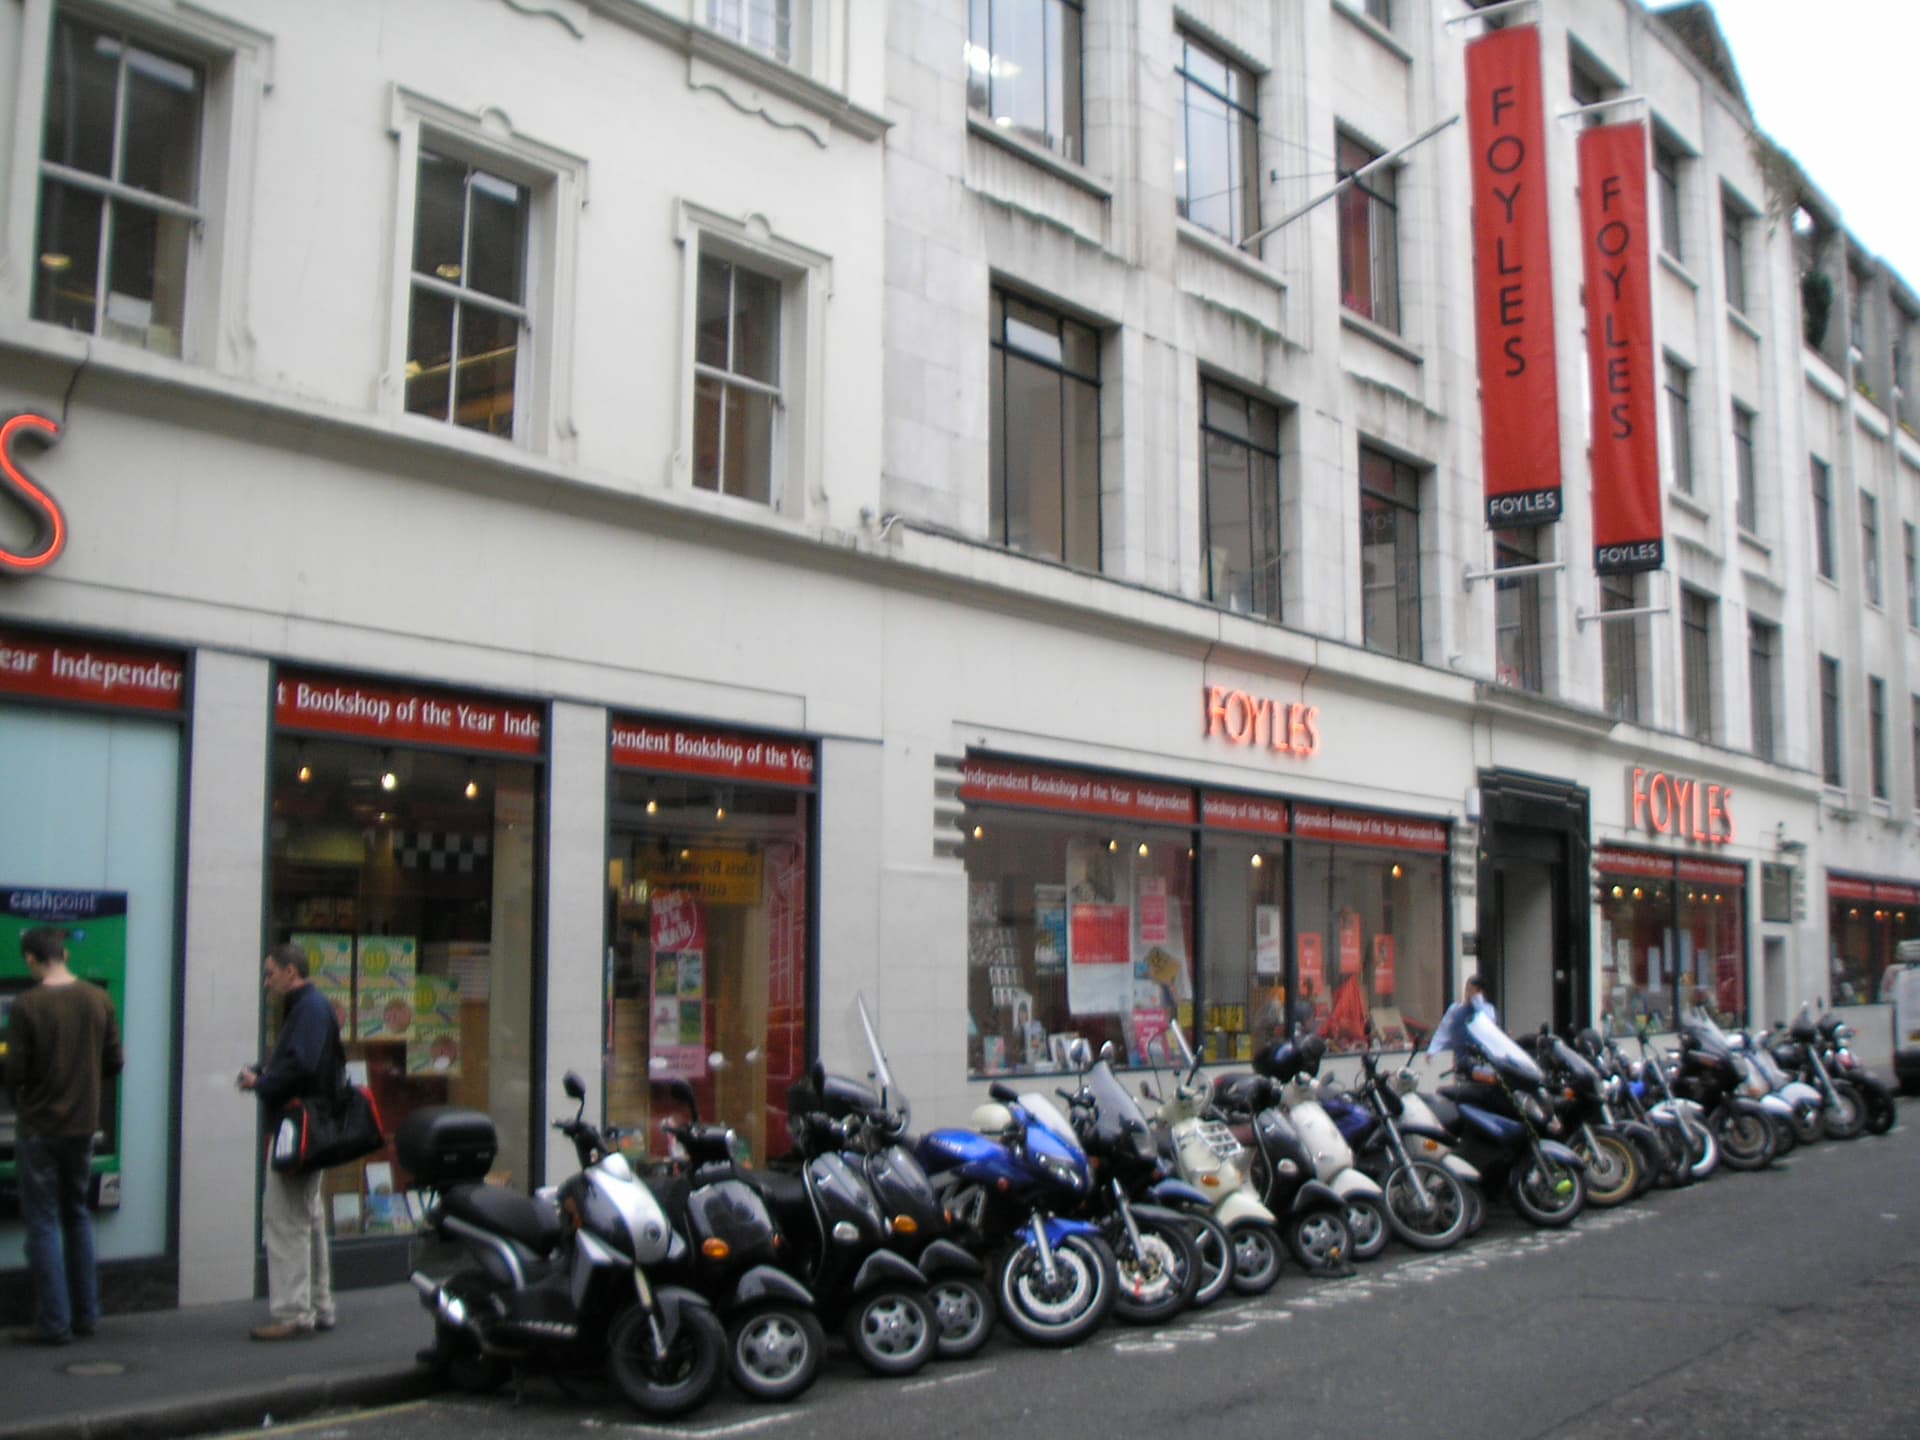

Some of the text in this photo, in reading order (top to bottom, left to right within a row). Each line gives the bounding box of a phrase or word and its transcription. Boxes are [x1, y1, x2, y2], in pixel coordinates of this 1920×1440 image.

[1486, 85, 1526, 378] FOYLES
[1596, 175, 1633, 440] FOYLES
[1489, 491, 1557, 517] FOYLES
[1599, 542, 1658, 565] FOYLES
[297, 682, 390, 725] Bookshop
[396, 697, 417, 722] of
[422, 700, 452, 727] the
[457, 704, 496, 733] Year
[504, 710, 541, 737] Inde
[1204, 686, 1322, 757] FOYLES
[675, 732, 743, 766] Bookshop
[747, 742, 761, 764] of
[765, 746, 788, 769] the
[963, 766, 1190, 812] Independent Bookshop of the Year Independent
[1630, 766, 1738, 846] FOYLES
[10, 890, 96, 912] cashpoint
